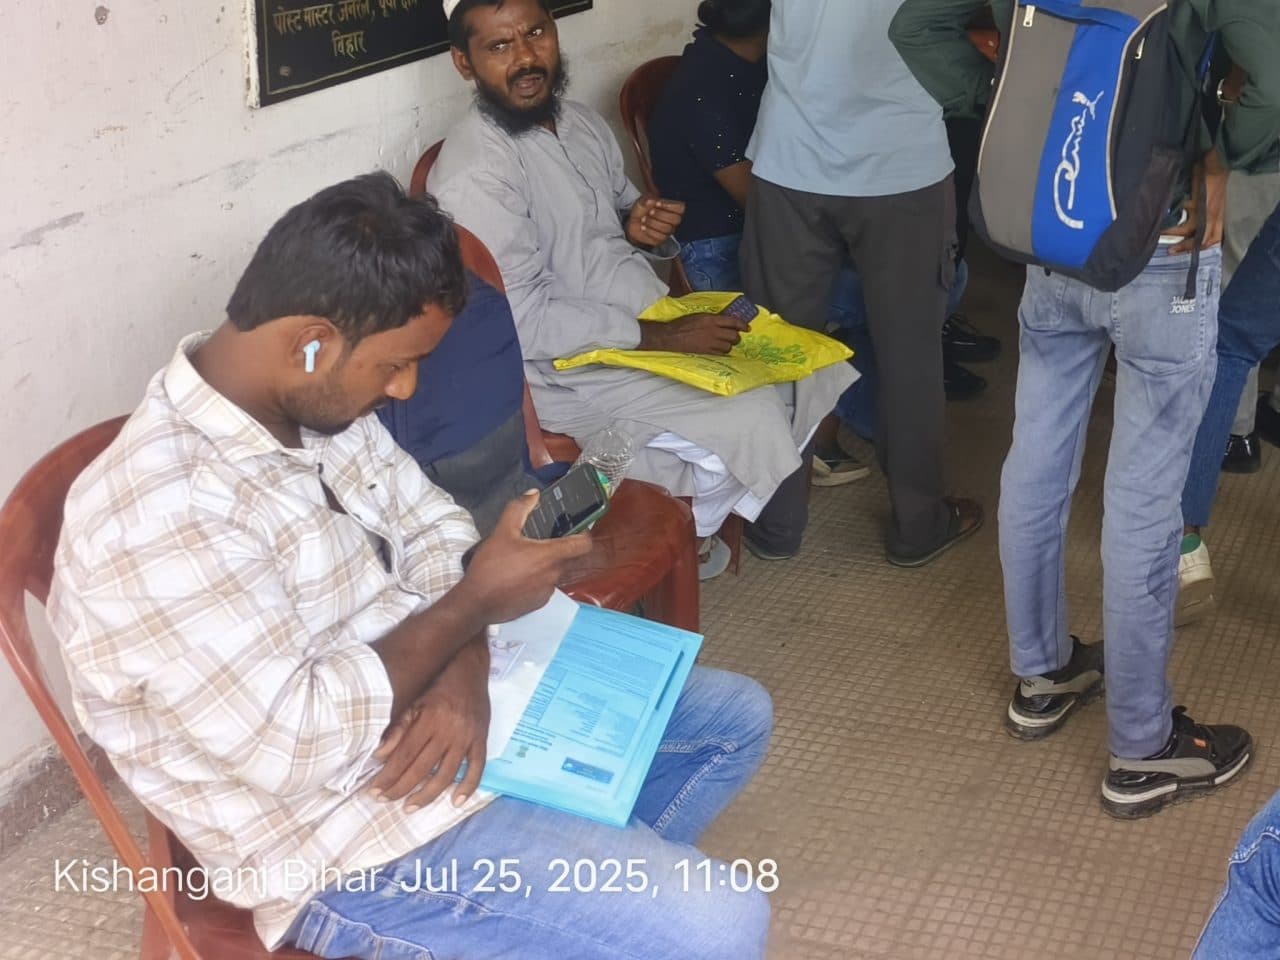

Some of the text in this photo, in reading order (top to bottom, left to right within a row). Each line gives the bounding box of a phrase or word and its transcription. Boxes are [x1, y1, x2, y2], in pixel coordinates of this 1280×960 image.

[272, 5, 302, 35] पोस्ट
[303, 3, 336, 28] मास्टर
[1169, 304, 1195, 313] JONES
